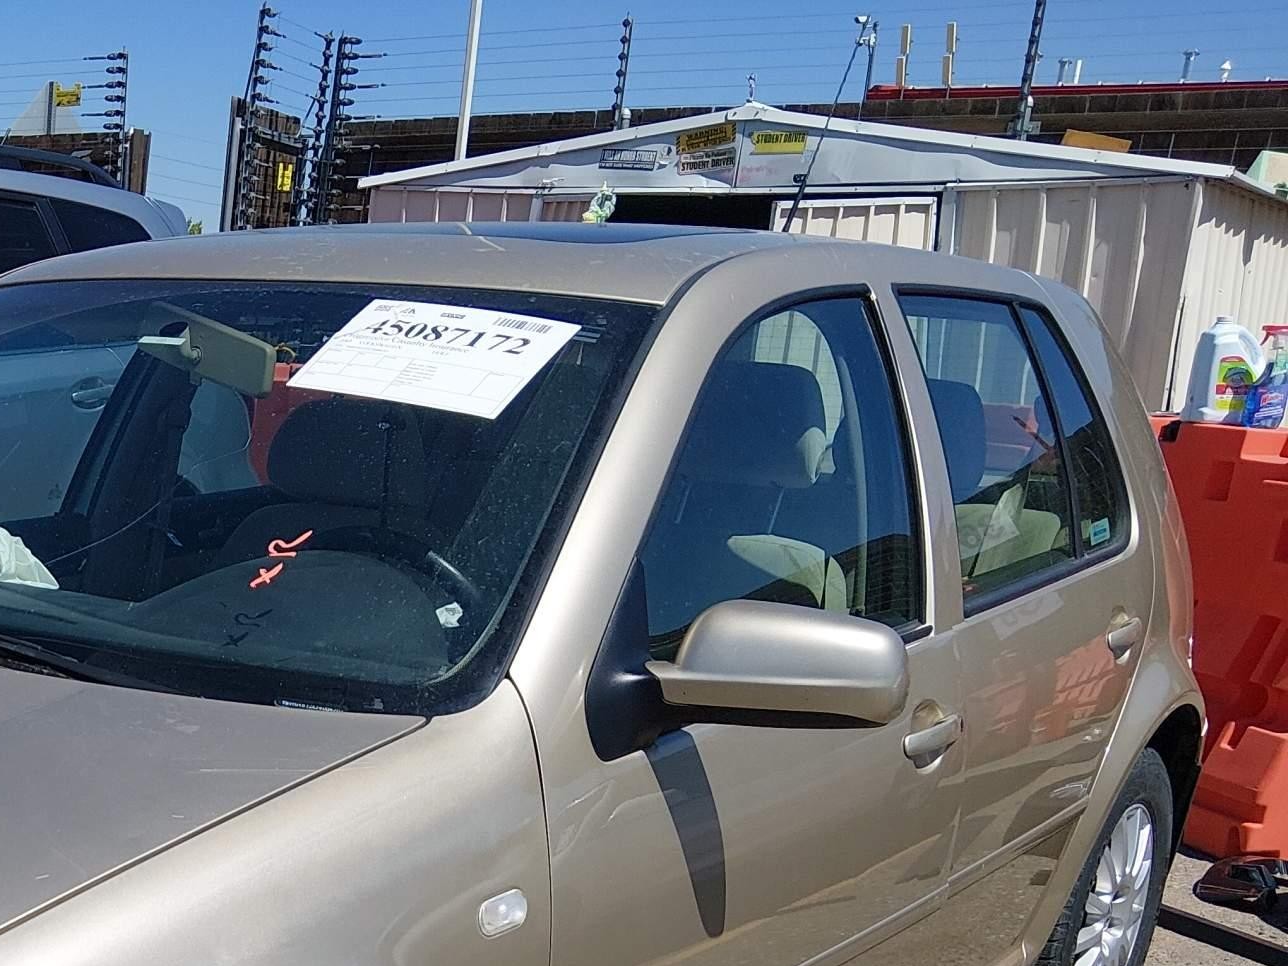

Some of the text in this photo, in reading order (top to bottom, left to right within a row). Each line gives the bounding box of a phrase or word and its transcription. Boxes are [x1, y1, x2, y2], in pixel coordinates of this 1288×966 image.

[756, 132, 807, 144] STUDENT DRIVER
[681, 157, 735, 171] STUDENT DRIVER
[366, 319, 532, 355] 45087172
